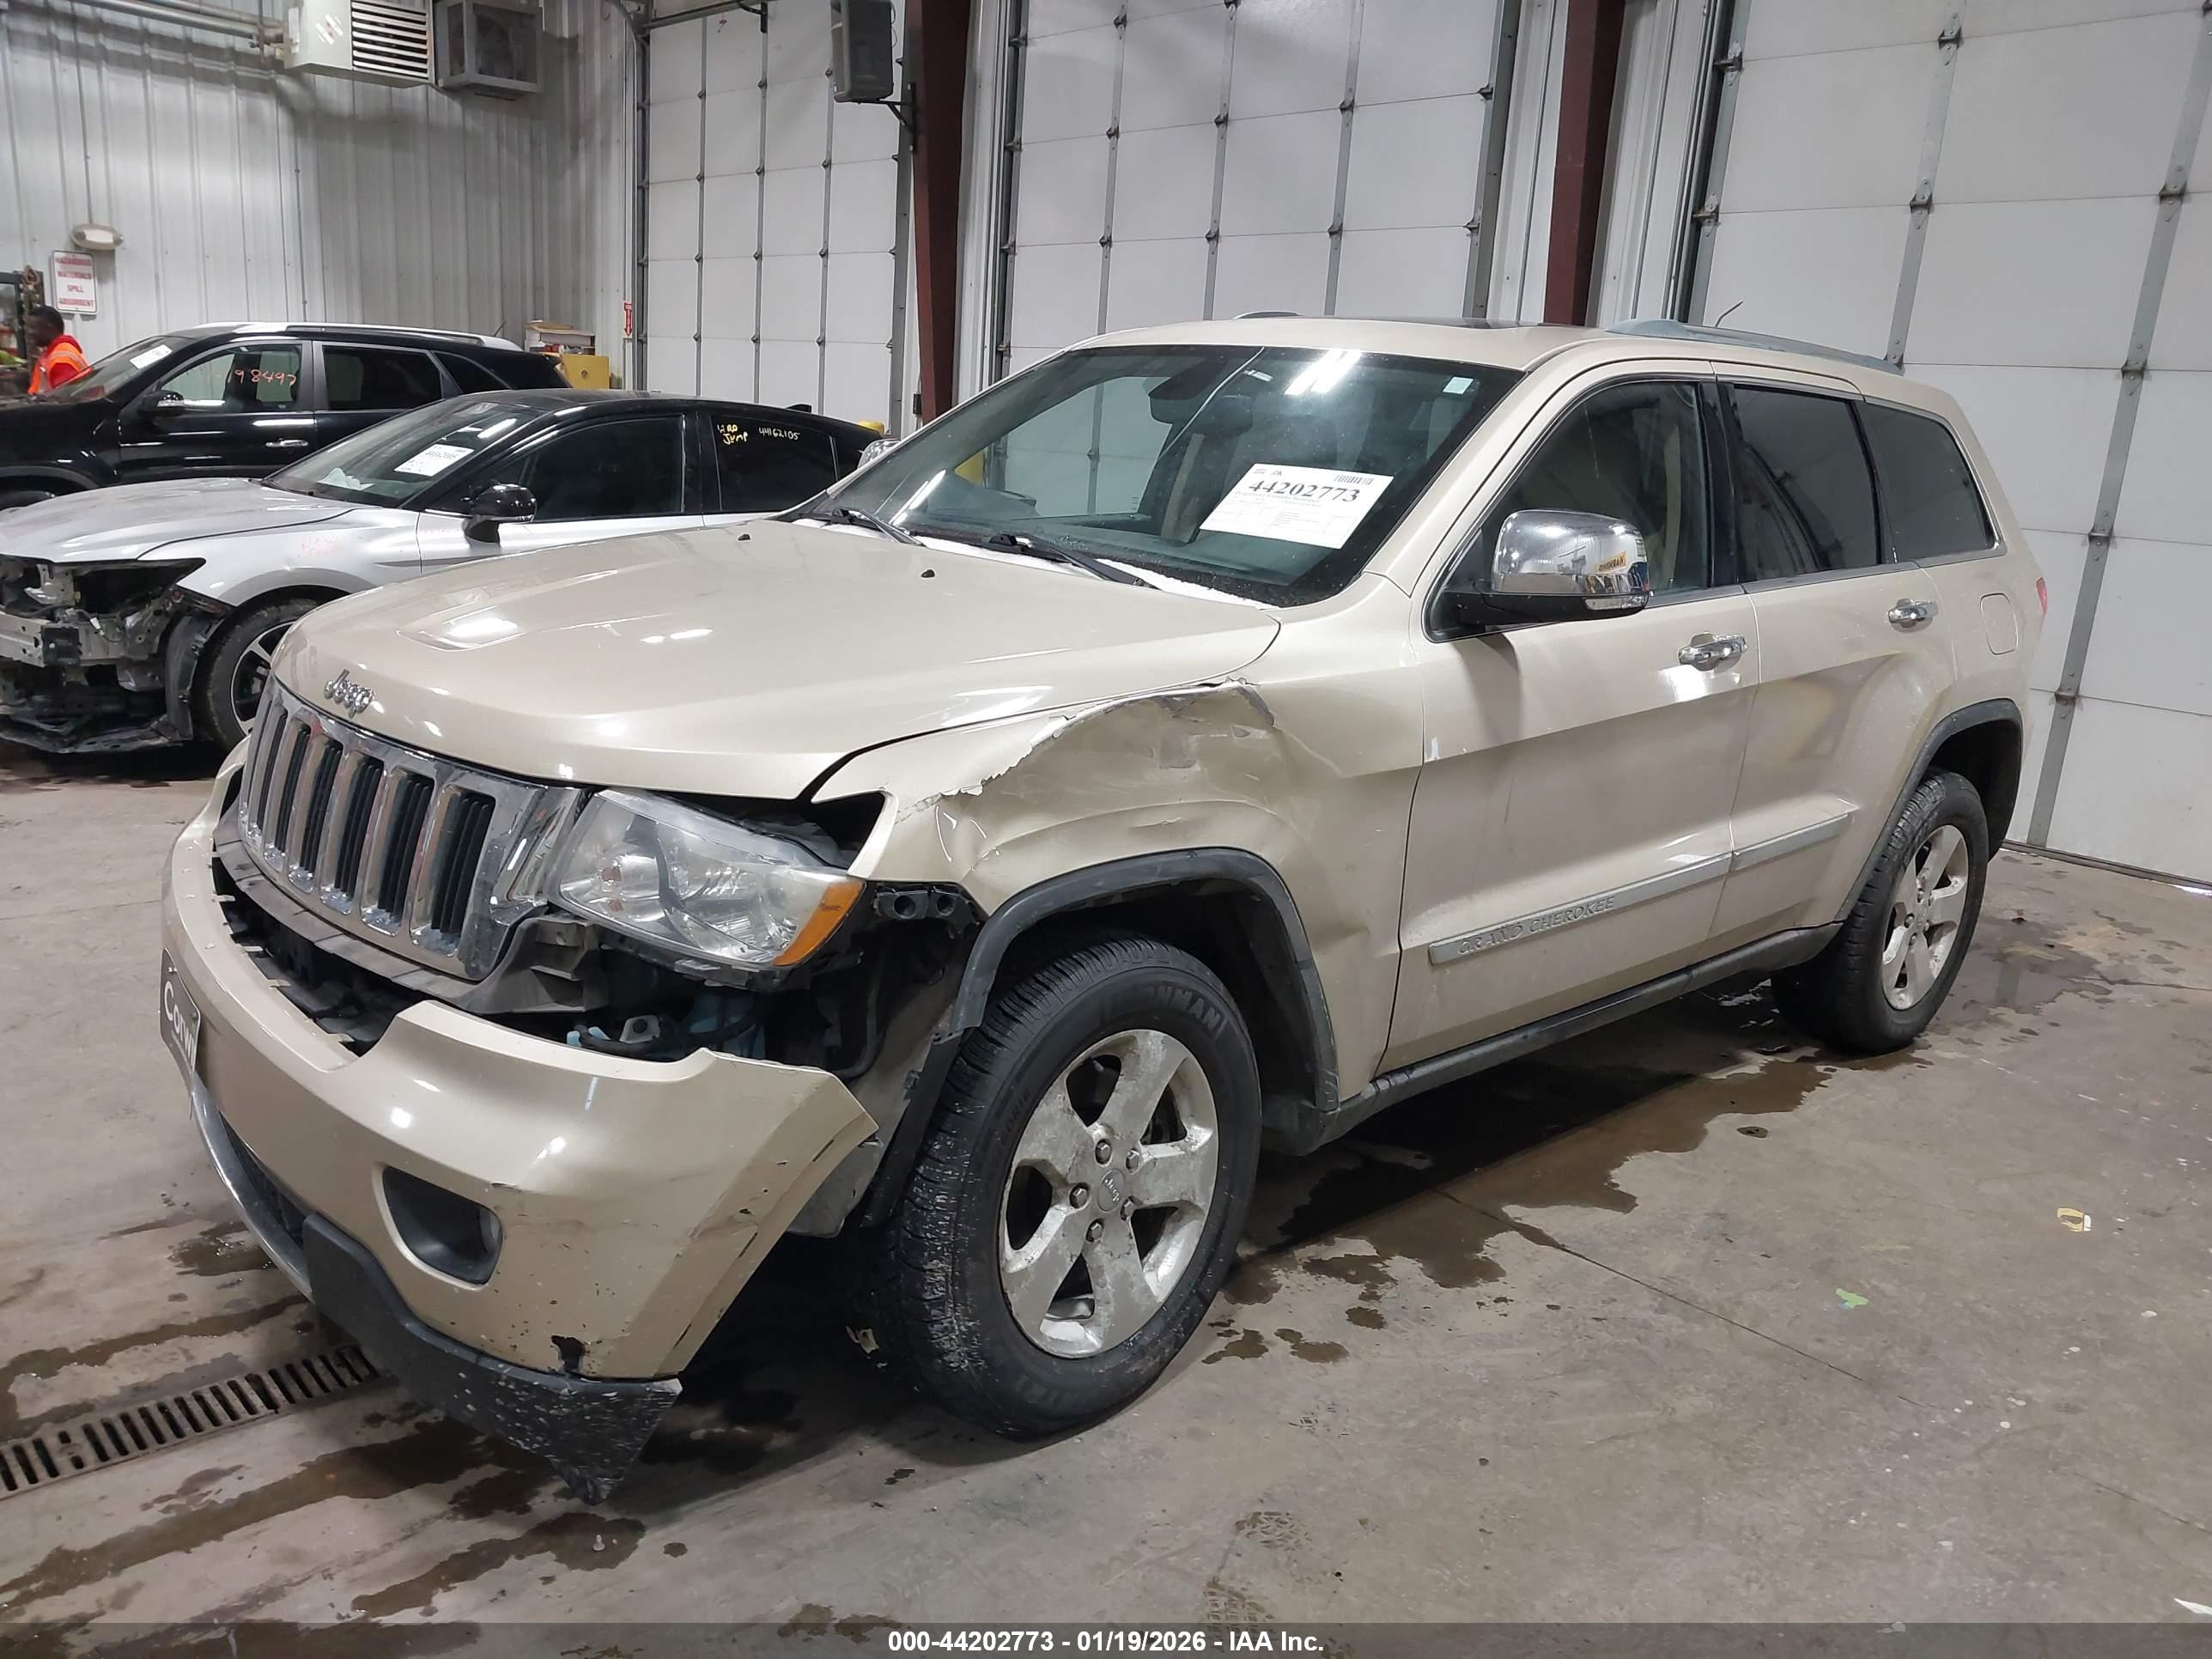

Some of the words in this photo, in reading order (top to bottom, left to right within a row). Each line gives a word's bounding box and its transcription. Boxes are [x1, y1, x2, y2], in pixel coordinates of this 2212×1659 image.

[758, 427, 801, 441] 44162105
[1249, 480, 1361, 502] 44202773
[1458, 923, 1523, 955] GRAND
[1529, 896, 1616, 934] CHEROKEE
